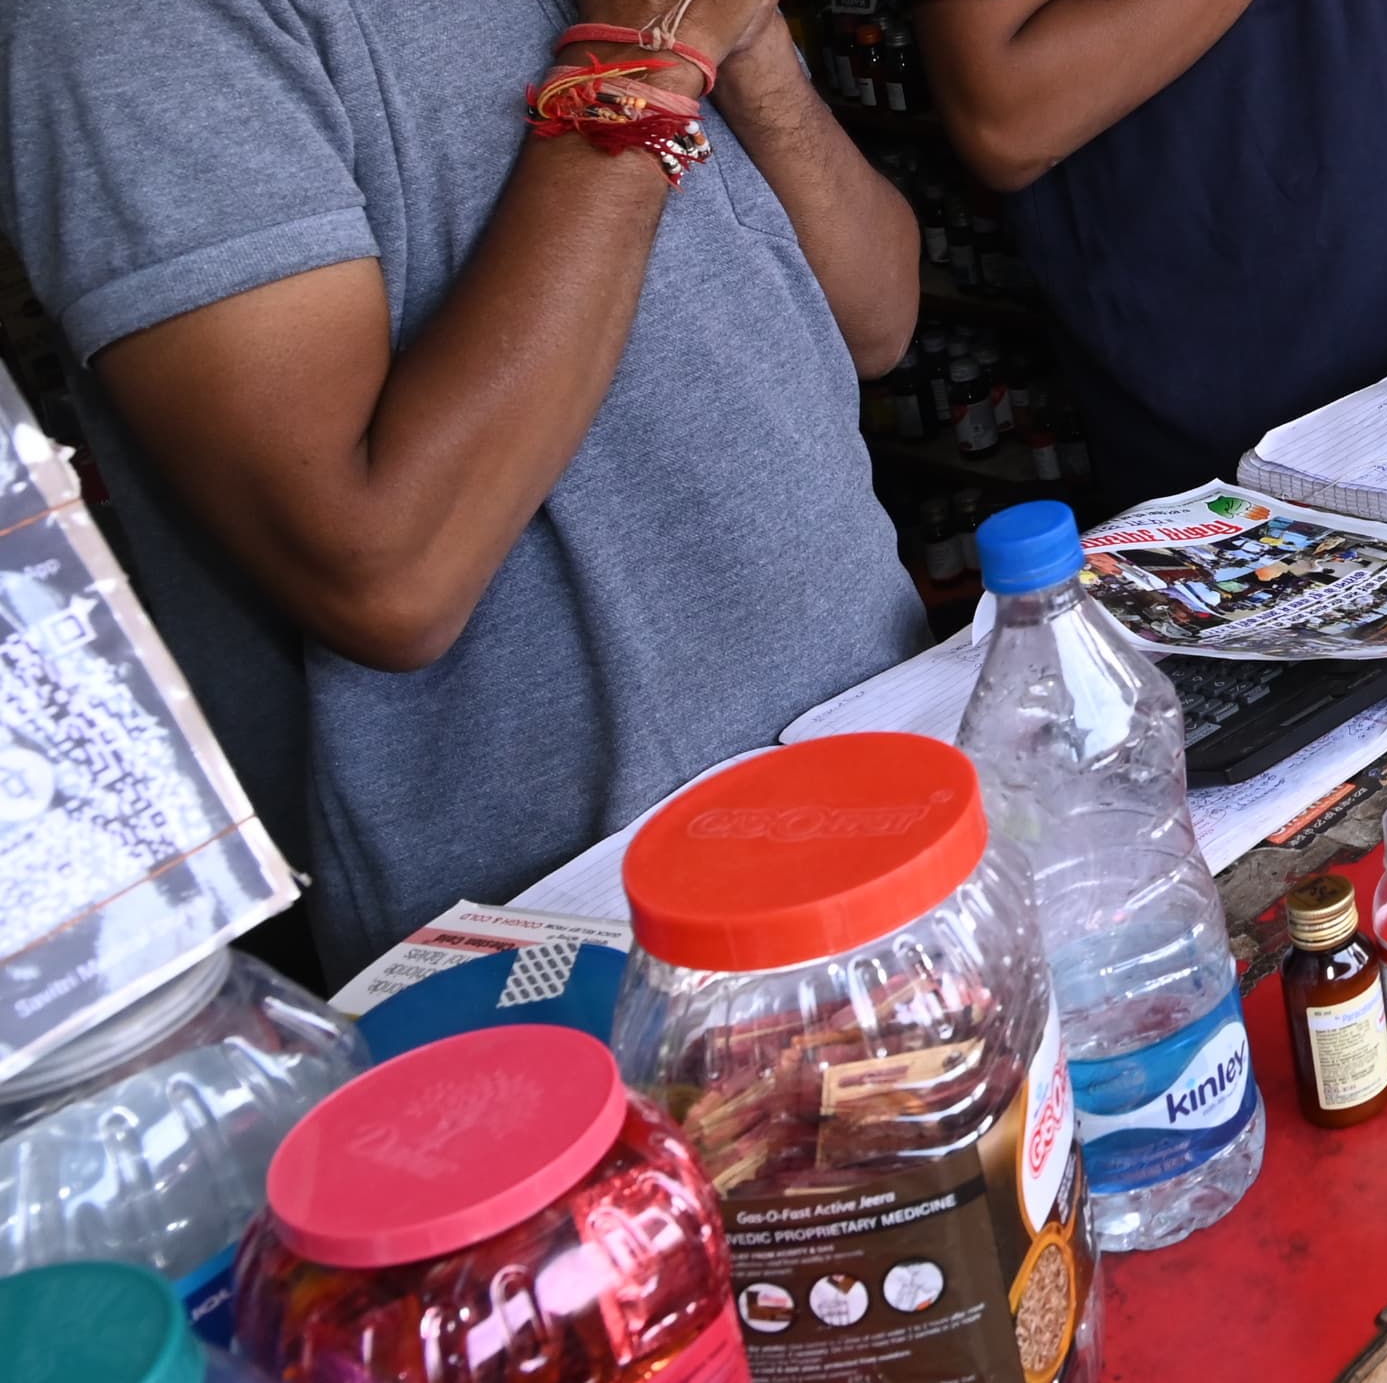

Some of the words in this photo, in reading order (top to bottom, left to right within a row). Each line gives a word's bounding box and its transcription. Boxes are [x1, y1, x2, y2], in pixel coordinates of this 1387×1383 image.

[459, 913, 493, 922] COLD
[502, 918, 542, 929] COUGH
[1165, 1039, 1248, 1124] kinley
[736, 1206, 811, 1225] Gas-O-Fast
[814, 1199, 855, 1216] Active
[858, 1191, 896, 1209] Jeera
[774, 1218, 877, 1244] PROPRIETARY
[881, 1193, 957, 1227] MEDICINE
